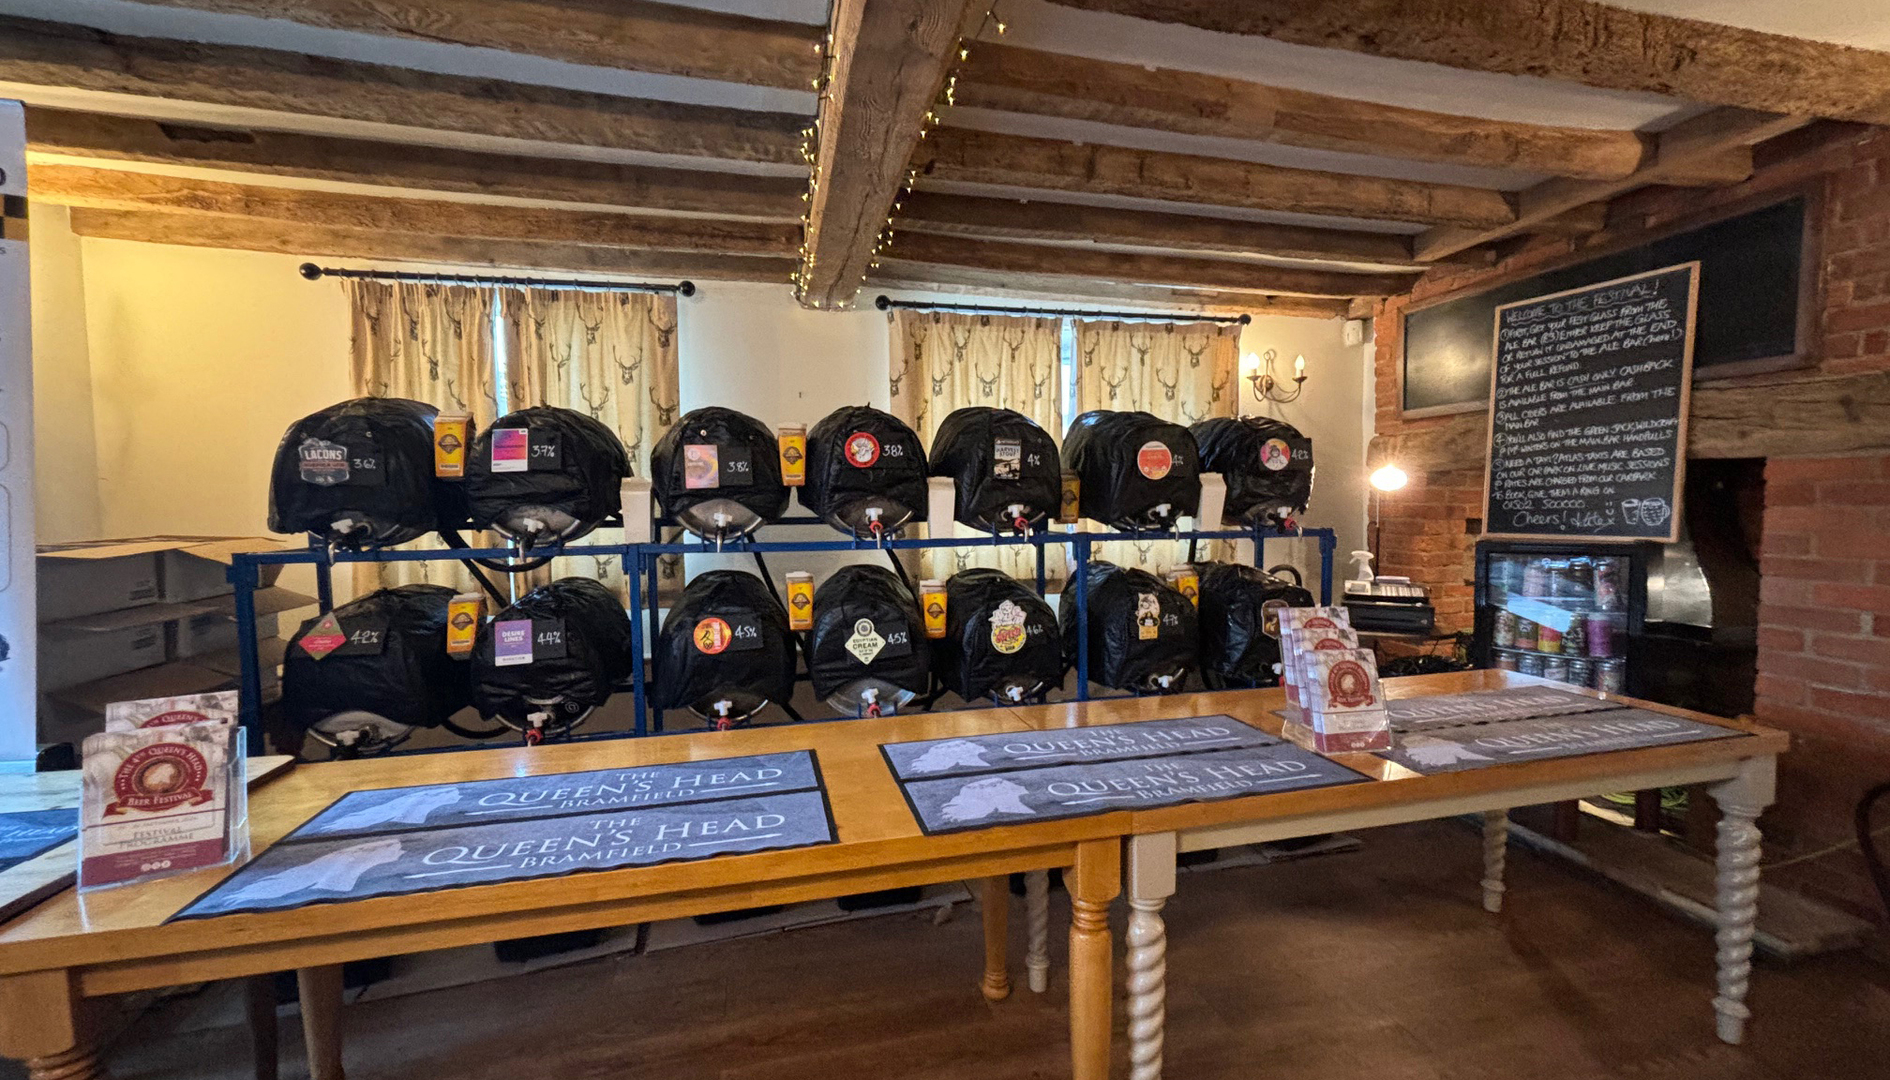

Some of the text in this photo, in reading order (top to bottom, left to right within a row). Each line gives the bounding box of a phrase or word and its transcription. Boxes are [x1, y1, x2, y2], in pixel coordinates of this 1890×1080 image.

[1506, 305, 1546, 323] WELCOME
[1549, 303, 1564, 314] TO
[1566, 296, 1589, 310] THE
[1590, 308, 1619, 321] GLASS
[1620, 305, 1644, 317] FROM
[1645, 298, 1668, 311] THE
[1505, 341, 1520, 351] ALE
[1521, 336, 1538, 347] BAR
[1590, 320, 1615, 333] KEEP
[1615, 317, 1633, 328] THE
[1634, 309, 1671, 325] GLASS
[1611, 330, 1627, 340] AT
[1628, 325, 1648, 336] THE
[1650, 319, 1678, 333] END
[1500, 364, 1511, 374] OF
[1535, 355, 1566, 367] SESSION
[1564, 350, 1579, 359] TO
[1580, 347, 1597, 356] THE
[1599, 342, 1620, 353] ALE
[1622, 337, 1644, 349] BAR
[1500, 374, 1514, 384] FOR
[1516, 372, 1523, 381] A
[1525, 368, 1547, 379] FULL
[1507, 386, 1520, 395] THE
[1522, 383, 1537, 393] ALE
[1539, 380, 1555, 391] BAR
[1557, 379, 1564, 387] IS
[1592, 367, 1616, 381] ONLY
[1499, 401, 1507, 409] IS
[1549, 391, 1568, 400] FROM
[1569, 388, 1588, 396] THE
[1589, 383, 1610, 395] MAIN
[1612, 378, 1634, 390] BAR
[1505, 412, 1520, 421] ALL
[1550, 404, 1566, 414] ARE
[1568, 395, 1617, 412] AVAILABLE
[1620, 391, 1649, 403] FROM
[1650, 387, 1676, 398] THE
[1505, 418, 1539, 432] MAIN BAR
[1527, 431, 1546, 441] ALSO
[1547, 429, 1565, 439] FIND
[1565, 427, 1582, 436] THE
[1584, 426, 1609, 436] GREEN
[1550, 440, 1561, 448] ON
[1562, 438, 1578, 447] THE
[1603, 435, 1620, 445] BAR
[304, 450, 342, 460] LACONS
[1027, 453, 1040, 467] 4%
[1505, 457, 1524, 468] NEED
[1525, 457, 1532, 465] A
[1610, 449, 1629, 459] ARE
[1631, 447, 1665, 458] BASED
[1496, 471, 1508, 480] ON
[1509, 468, 1525, 477] OUR
[1563, 464, 1575, 473] ON
[1625, 458, 1671, 470] SESSIONS
[1528, 478, 1543, 487] ARE
[1578, 473, 1598, 484] FROM
[1599, 473, 1614, 482] OUR
[1527, 489, 1547, 498] GIVE
[1548, 487, 1571, 497] THEM
[1572, 486, 1579, 495] A
[1580, 485, 1600, 496] RING
[1603, 486, 1615, 494] ON
[1513, 511, 1567, 530] Cheers!
[1004, 727, 1230, 754] QUEEN'S HEAD
[478, 768, 783, 806] QUEEN'S HEAD
[616, 772, 660, 781] THE
[1048, 760, 1307, 795] QUEEN'S HEAD
[128, 792, 192, 806] BEER FESTIVAL
[560, 789, 694, 808] BRAMFIELD
[1135, 780, 1253, 799] BRAMFIELD
[589, 817, 642, 830] THE
[422, 814, 786, 865] QUEEN'S HEAD
[519, 842, 682, 868] BRAMFIELD
